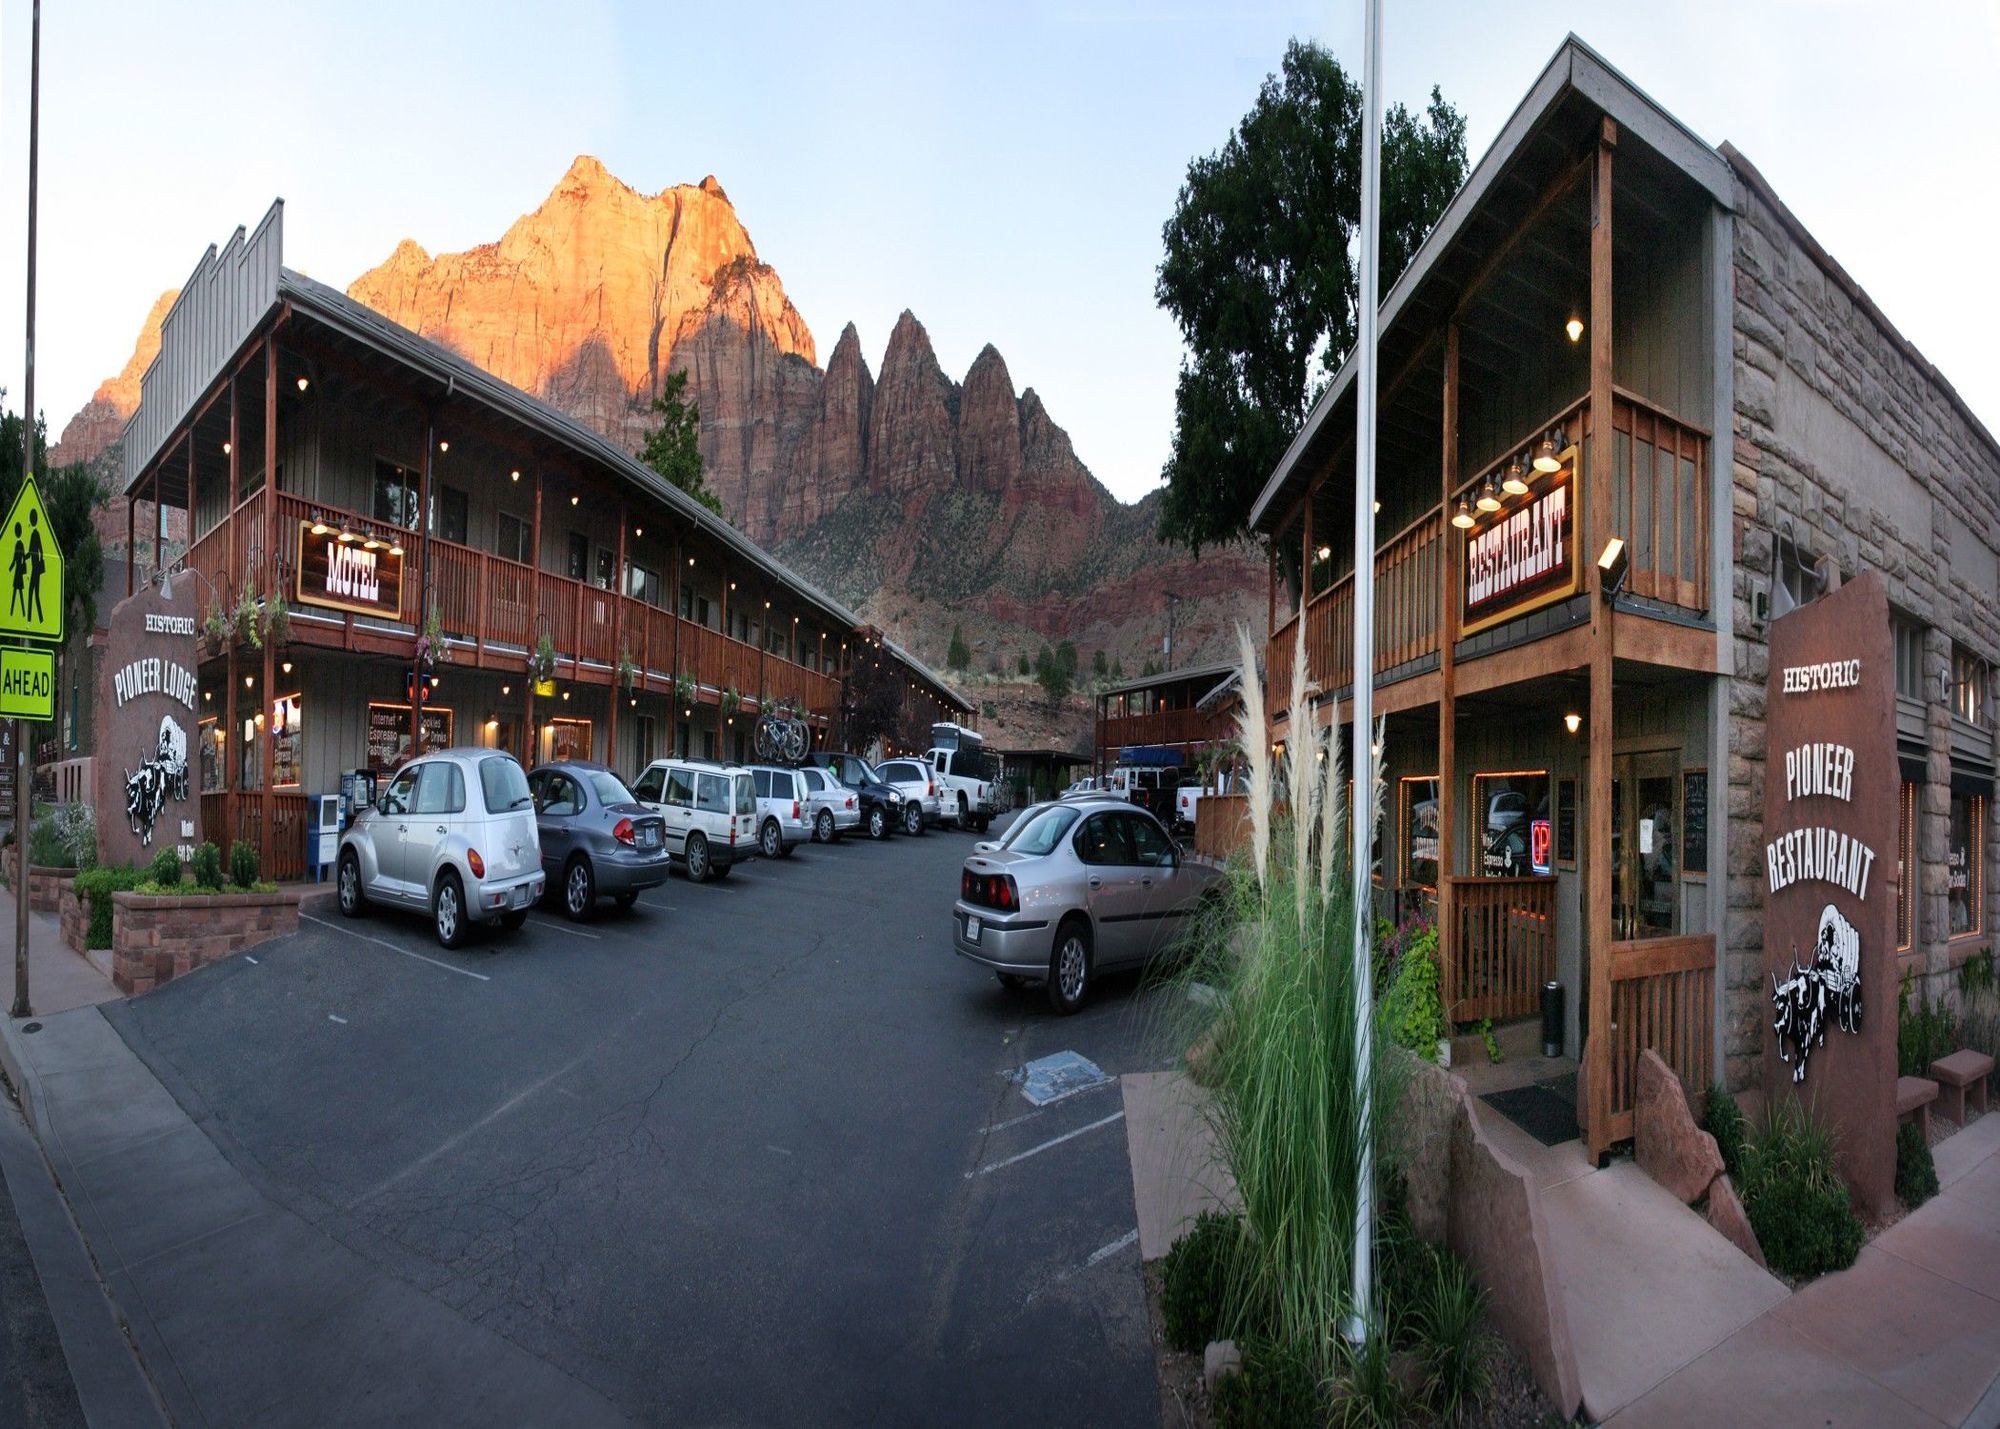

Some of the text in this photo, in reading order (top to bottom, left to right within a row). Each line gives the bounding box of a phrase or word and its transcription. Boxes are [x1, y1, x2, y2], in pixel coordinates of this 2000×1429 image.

[1469, 486, 1565, 606] RESTAURANT
[326, 541, 379, 601] MOTEL
[145, 613, 195, 635] HISTORIC
[3, 668, 50, 698] AHEAD
[114, 657, 197, 710] PIONEER LODGE
[1783, 659, 1860, 693] HISTORIC
[369, 726, 398, 744] Espresso
[1786, 743, 1855, 802] PIONEER
[1483, 850, 1504, 869] Espresso
[1766, 827, 1876, 901] RESTAURANT
